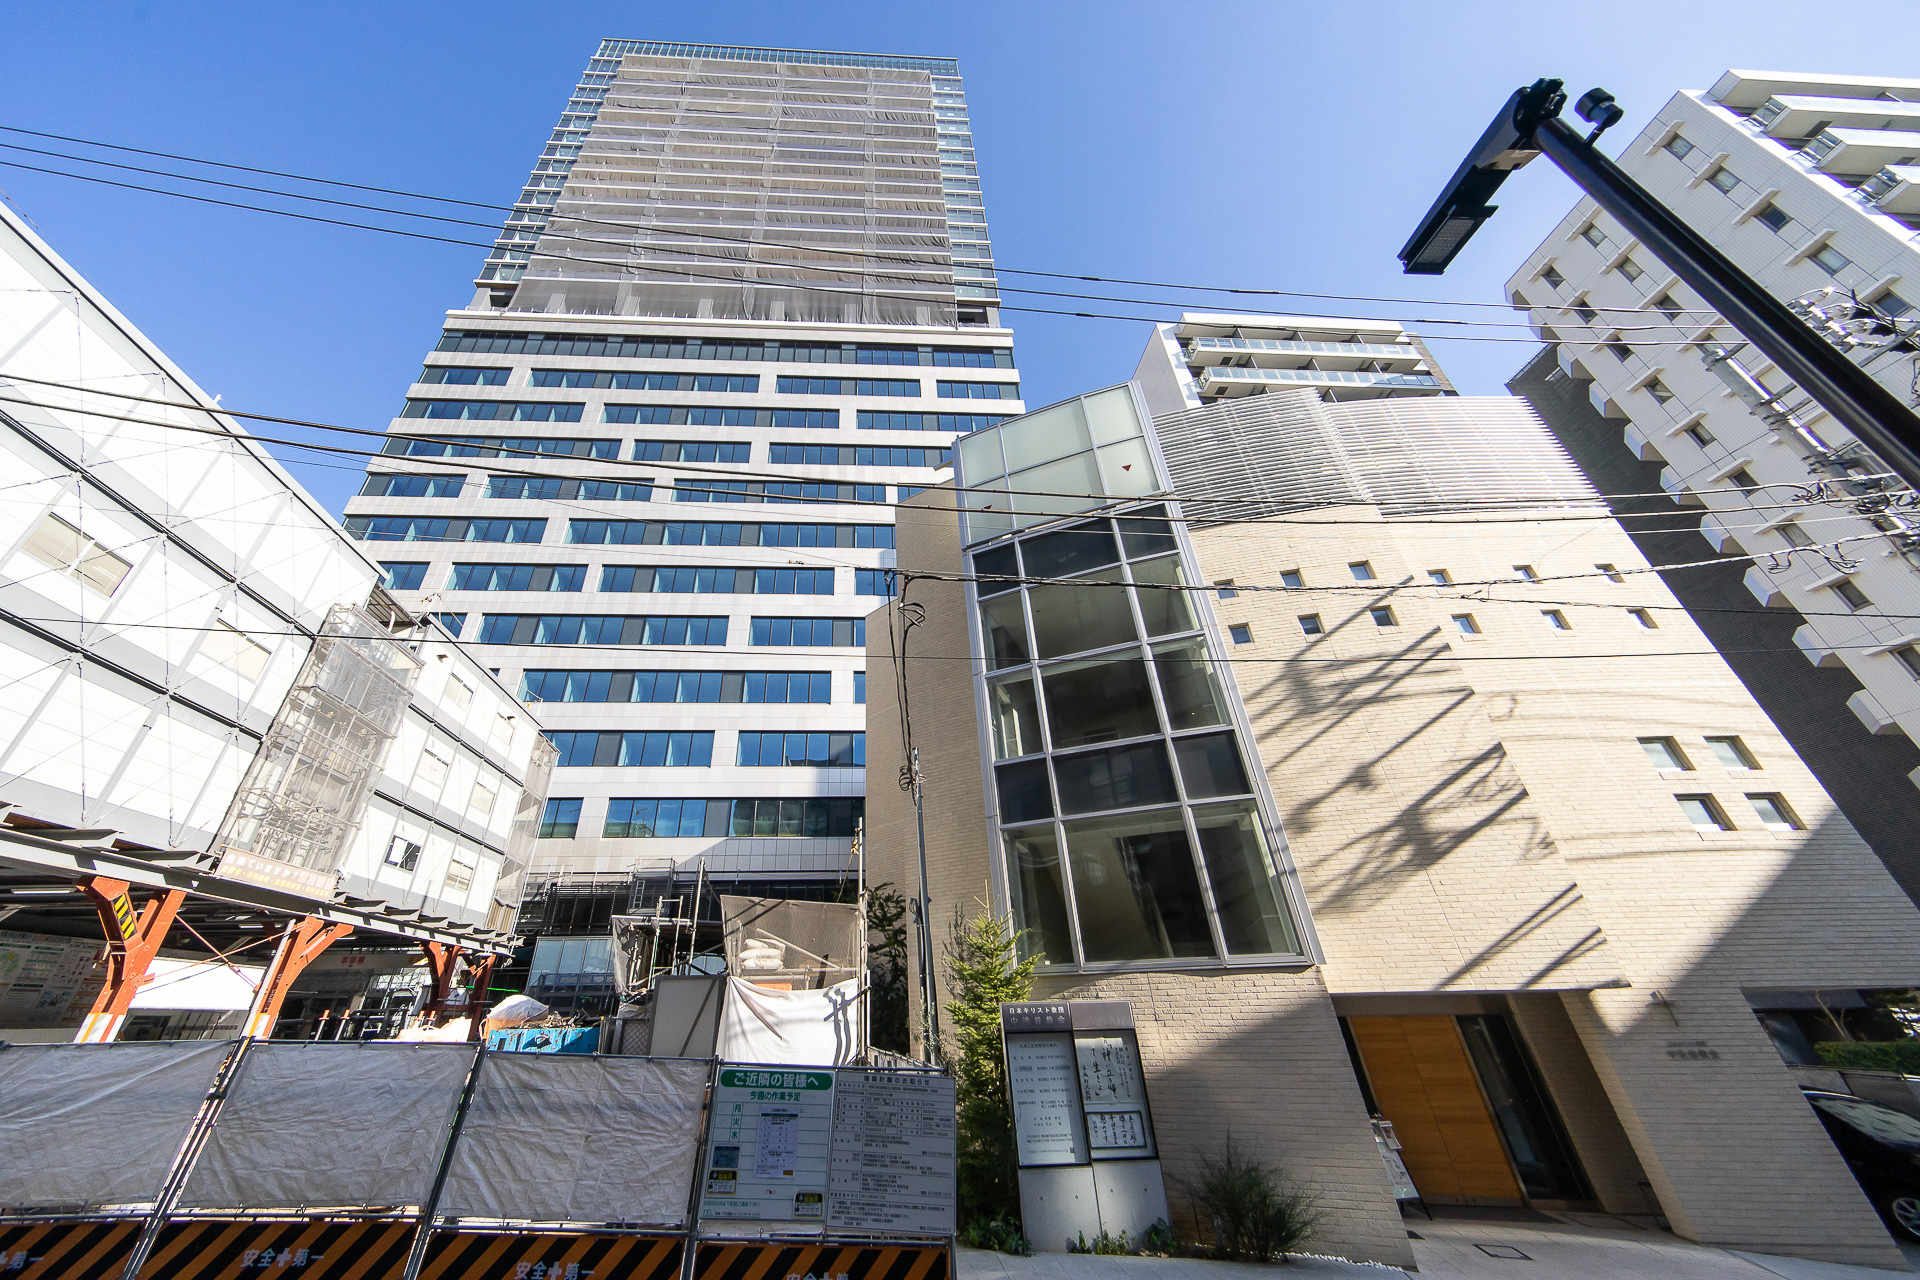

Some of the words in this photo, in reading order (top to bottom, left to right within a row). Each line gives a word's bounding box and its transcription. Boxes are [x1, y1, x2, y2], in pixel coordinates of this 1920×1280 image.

[1009, 1006, 1065, 1014] 日本キリスト教団
[734, 1072, 819, 1088] ご近隣の皆様へ
[863, 1075, 930, 1086] 建築計画のお知らせ
[750, 1090, 802, 1102] 今週の作業予定
[734, 1104, 743, 1112] 月
[732, 1117, 741, 1126] 火
[731, 1130, 739, 1140] 水
